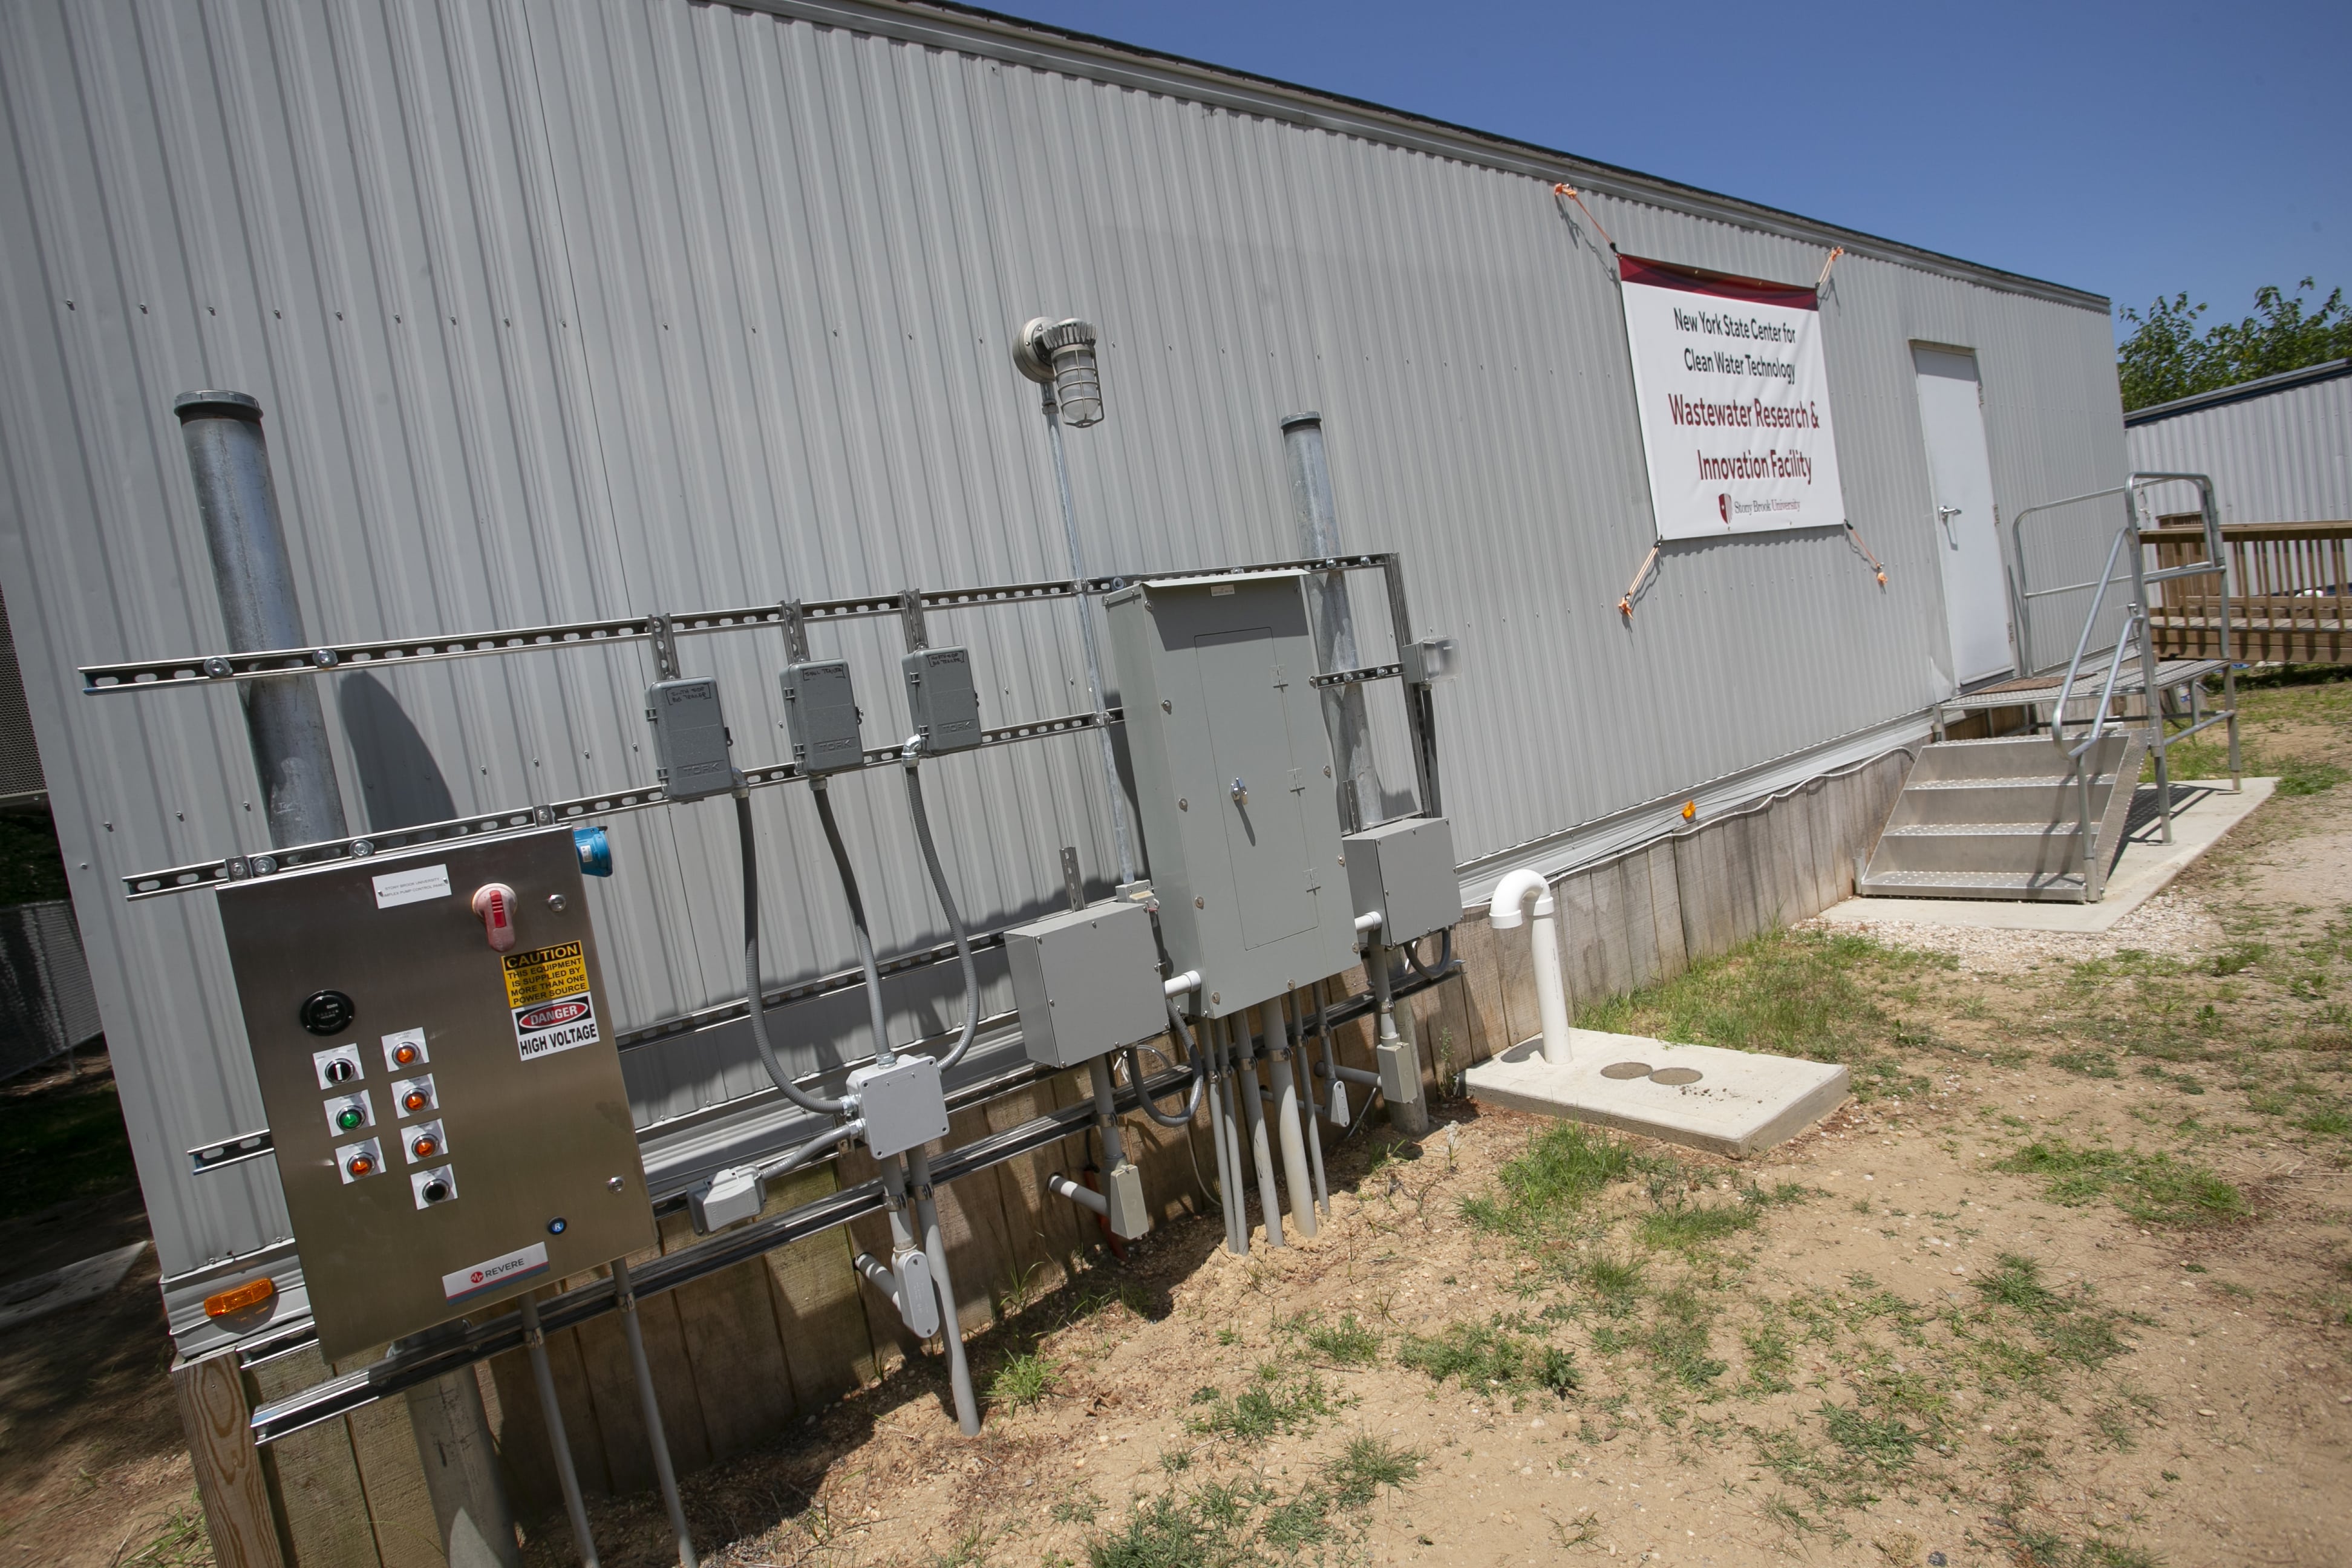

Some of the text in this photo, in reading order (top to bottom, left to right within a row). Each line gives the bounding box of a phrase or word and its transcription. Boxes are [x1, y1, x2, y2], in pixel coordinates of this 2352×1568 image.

[1674, 307, 1796, 344] New York State Center for
[1684, 347, 1795, 385] Clean Water Technology
[1668, 393, 1820, 429] Wastewater Research &
[1697, 449, 1812, 485] Innovation Facility
[1734, 498, 1801, 515] Stony Brook University
[942, 721, 972, 733] TORK
[818, 739, 852, 752] TORK
[683, 762, 719, 776] TORK
[506, 944, 578, 968] CAUTION
[507, 958, 582, 979] THIS EQUIPMENT
[523, 971, 567, 985] SUPPLIED
[569, 967, 581, 975] BY
[511, 975, 585, 997] MORE THAN ONE
[513, 982, 586, 1005] POWER SOURCE
[530, 1005, 578, 1025] DANGER
[520, 1024, 597, 1056] HIGH VOLTAGE
[485, 1258, 524, 1278] REVERE
